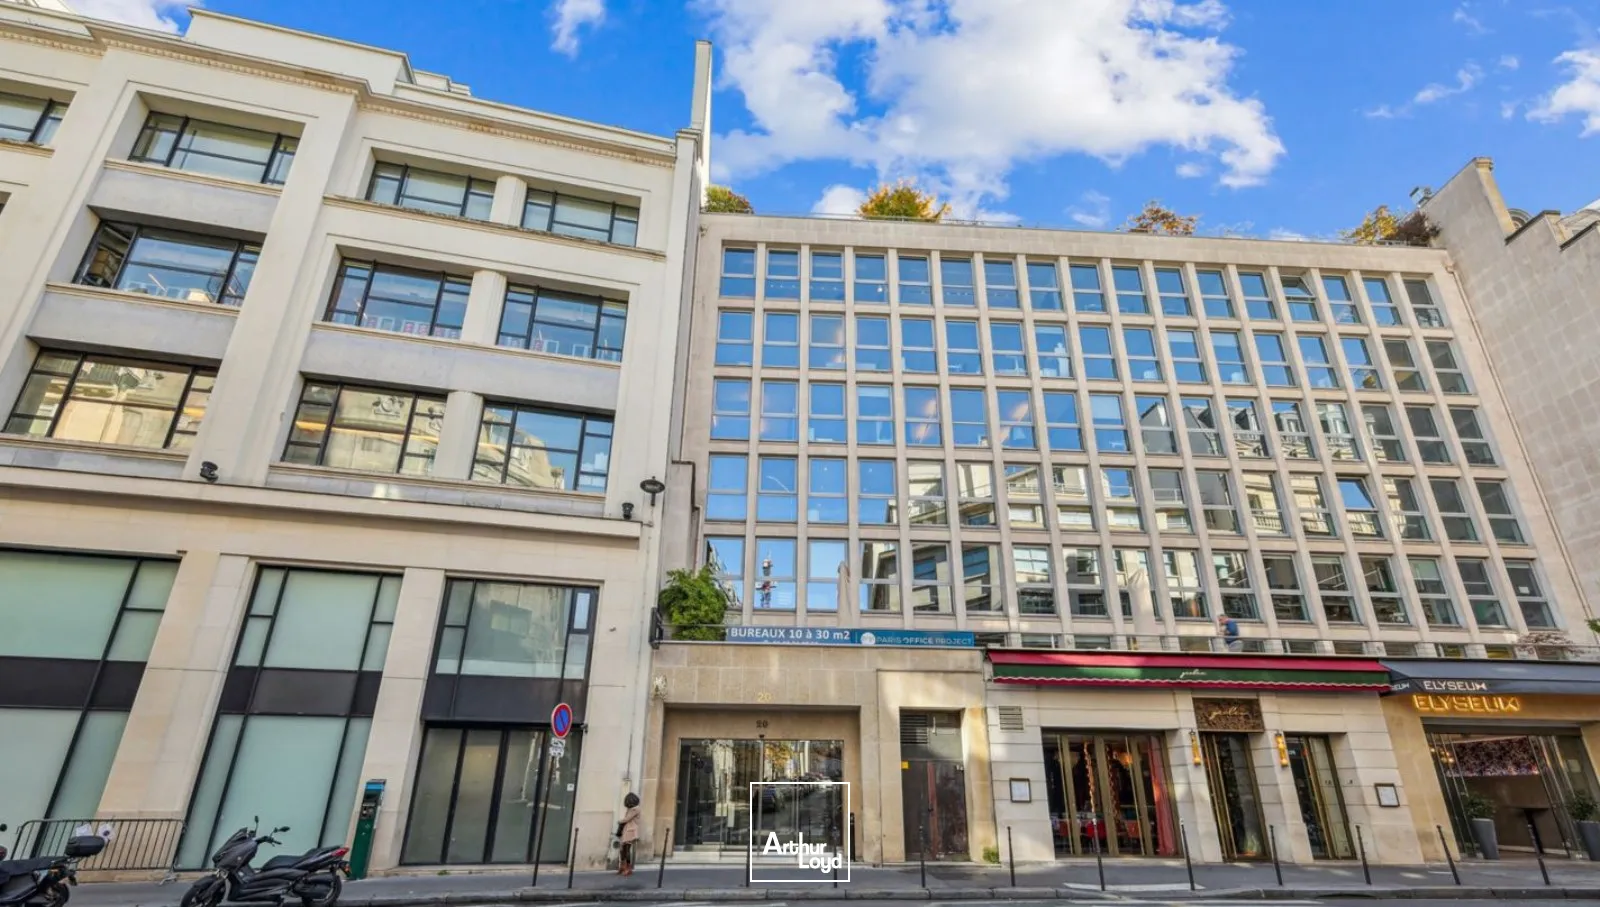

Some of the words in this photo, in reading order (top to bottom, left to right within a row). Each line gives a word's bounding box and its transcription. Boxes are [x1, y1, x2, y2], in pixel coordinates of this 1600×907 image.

[730, 627, 785, 638] BUREAUX
[789, 629, 802, 639] 10
[805, 629, 812, 639] à
[815, 630, 830, 640] 30
[833, 630, 850, 641] m2
[876, 635, 902, 644] PARIS
[903, 636, 934, 645] OFFICE
[935, 637, 972, 646] PROJECT
